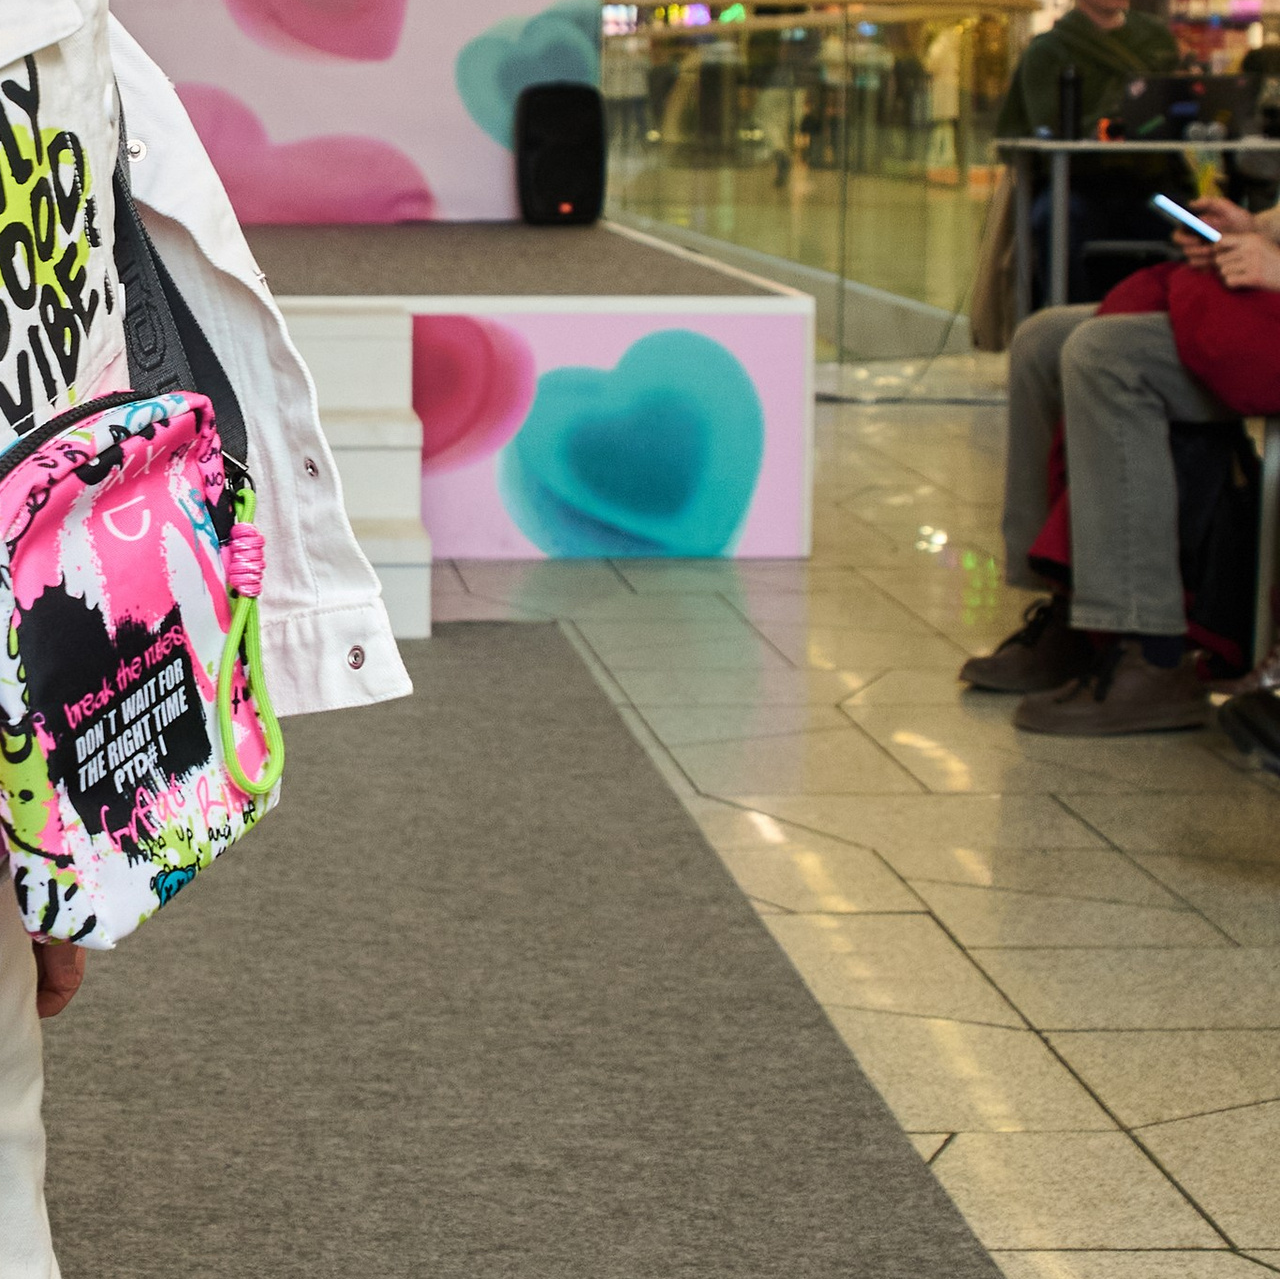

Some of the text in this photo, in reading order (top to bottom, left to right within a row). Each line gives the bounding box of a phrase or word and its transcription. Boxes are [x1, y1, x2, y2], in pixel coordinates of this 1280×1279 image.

[115, 658, 142, 692] the
[121, 677, 157, 725] WAIT
[158, 658, 185, 696] FOR
[78, 685, 189, 793] THE RIGHT TIME
